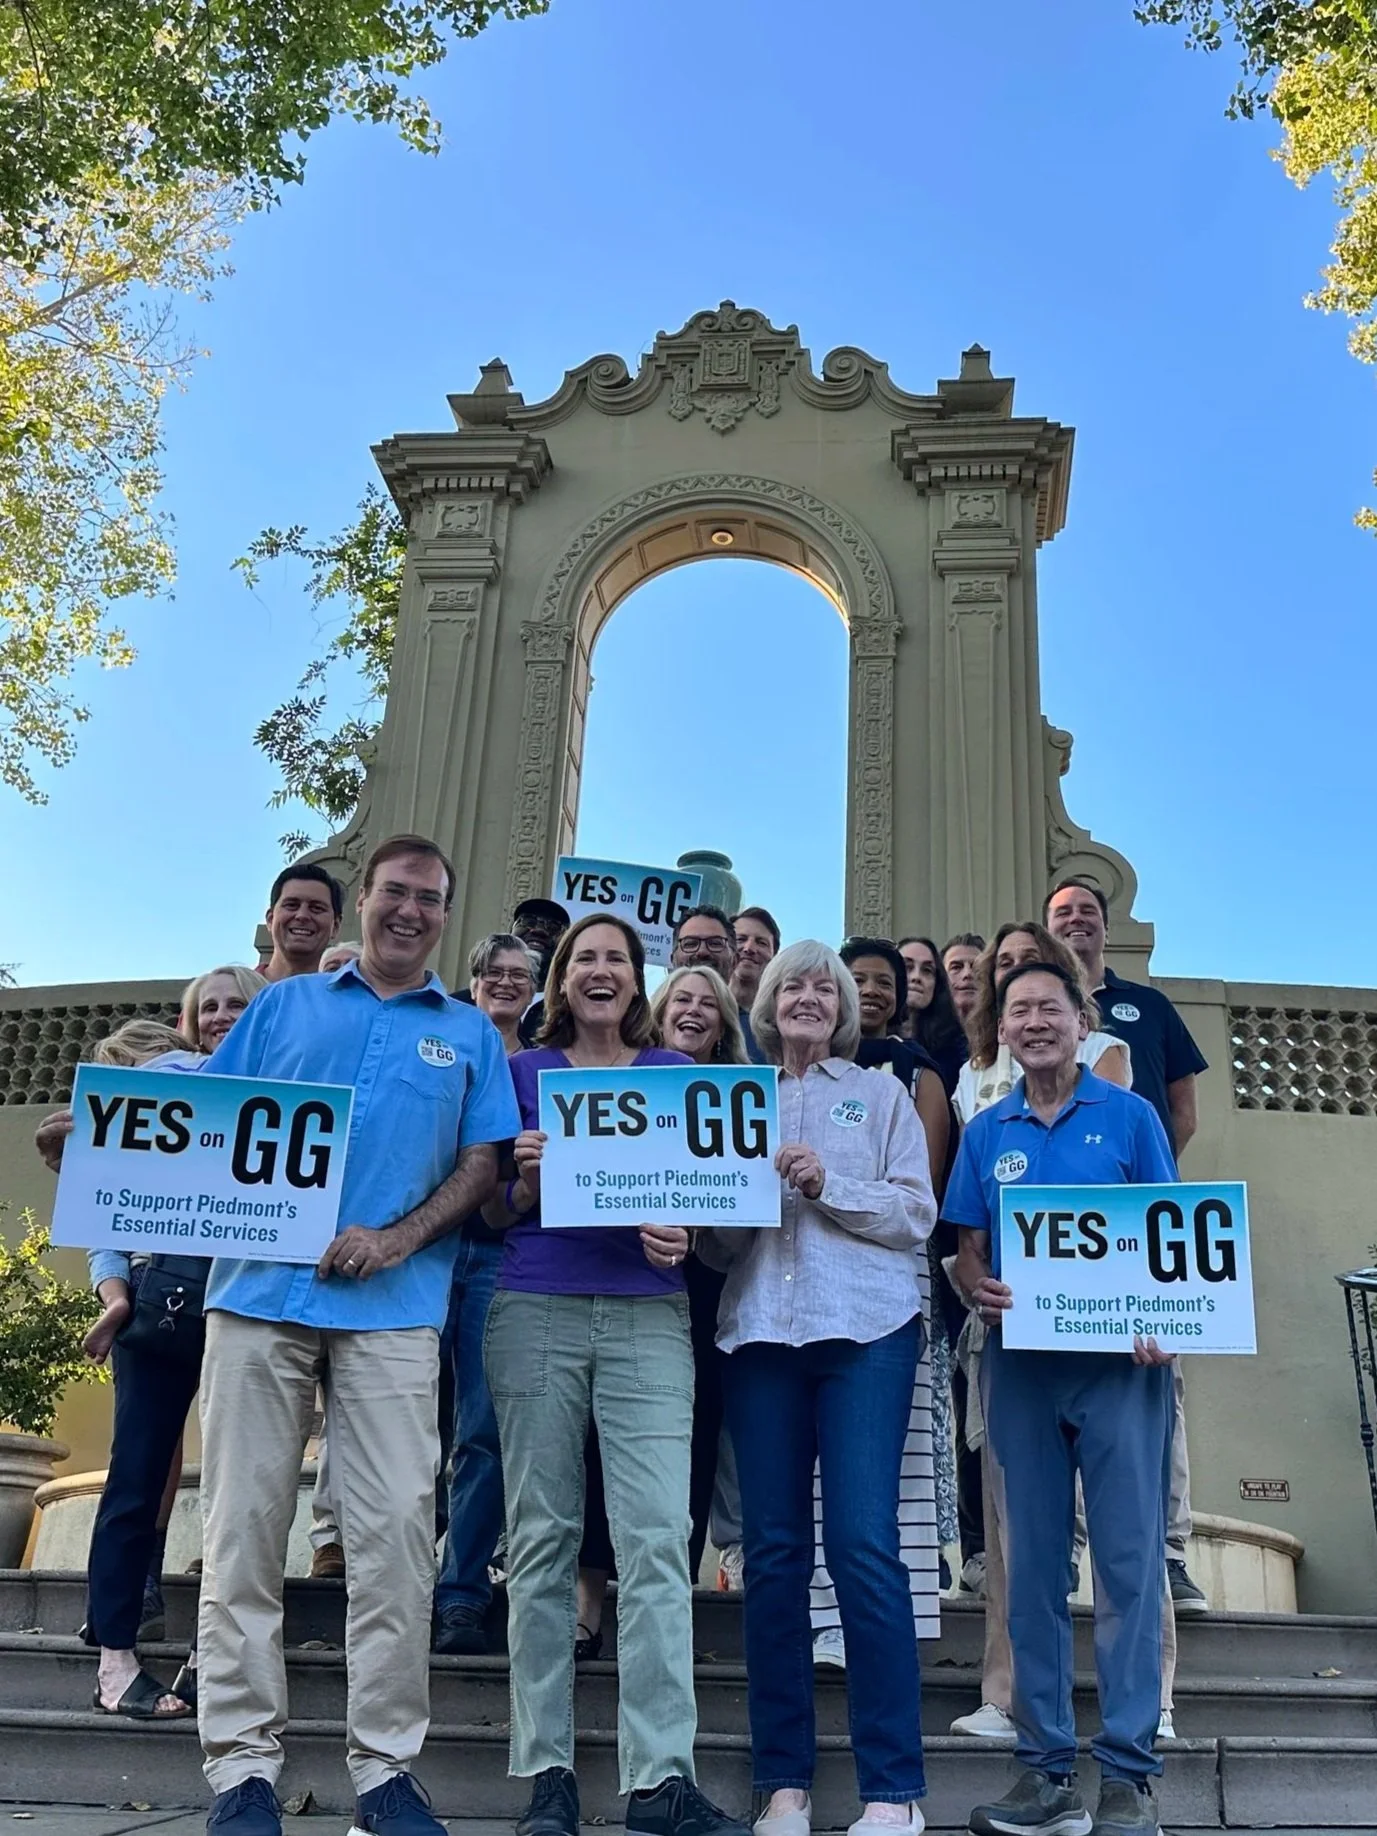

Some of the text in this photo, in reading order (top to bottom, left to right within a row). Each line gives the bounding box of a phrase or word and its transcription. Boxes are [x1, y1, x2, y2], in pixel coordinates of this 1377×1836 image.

[564, 872, 692, 928] YES on GG
[424, 1037, 442, 1048] YES
[436, 1048, 453, 1061] GG
[842, 1101, 858, 1111] YES
[552, 1080, 768, 1159] YES on GG
[845, 1111, 863, 1123] GG
[86, 1094, 334, 1189] YES on GG
[999, 1154, 1014, 1165] YES
[1009, 1159, 1025, 1172] GG
[575, 1170, 749, 1190] to Support Piedmont's
[96, 1189, 297, 1219] to Support Piedmont's
[594, 1191, 736, 1209] Essential Services
[112, 1214, 278, 1242] Essential Services
[1013, 1199, 1237, 1283] YES on GG
[1036, 1294, 1215, 1314] to Support Piedmont's
[1054, 1316, 1203, 1336] Essential Services
